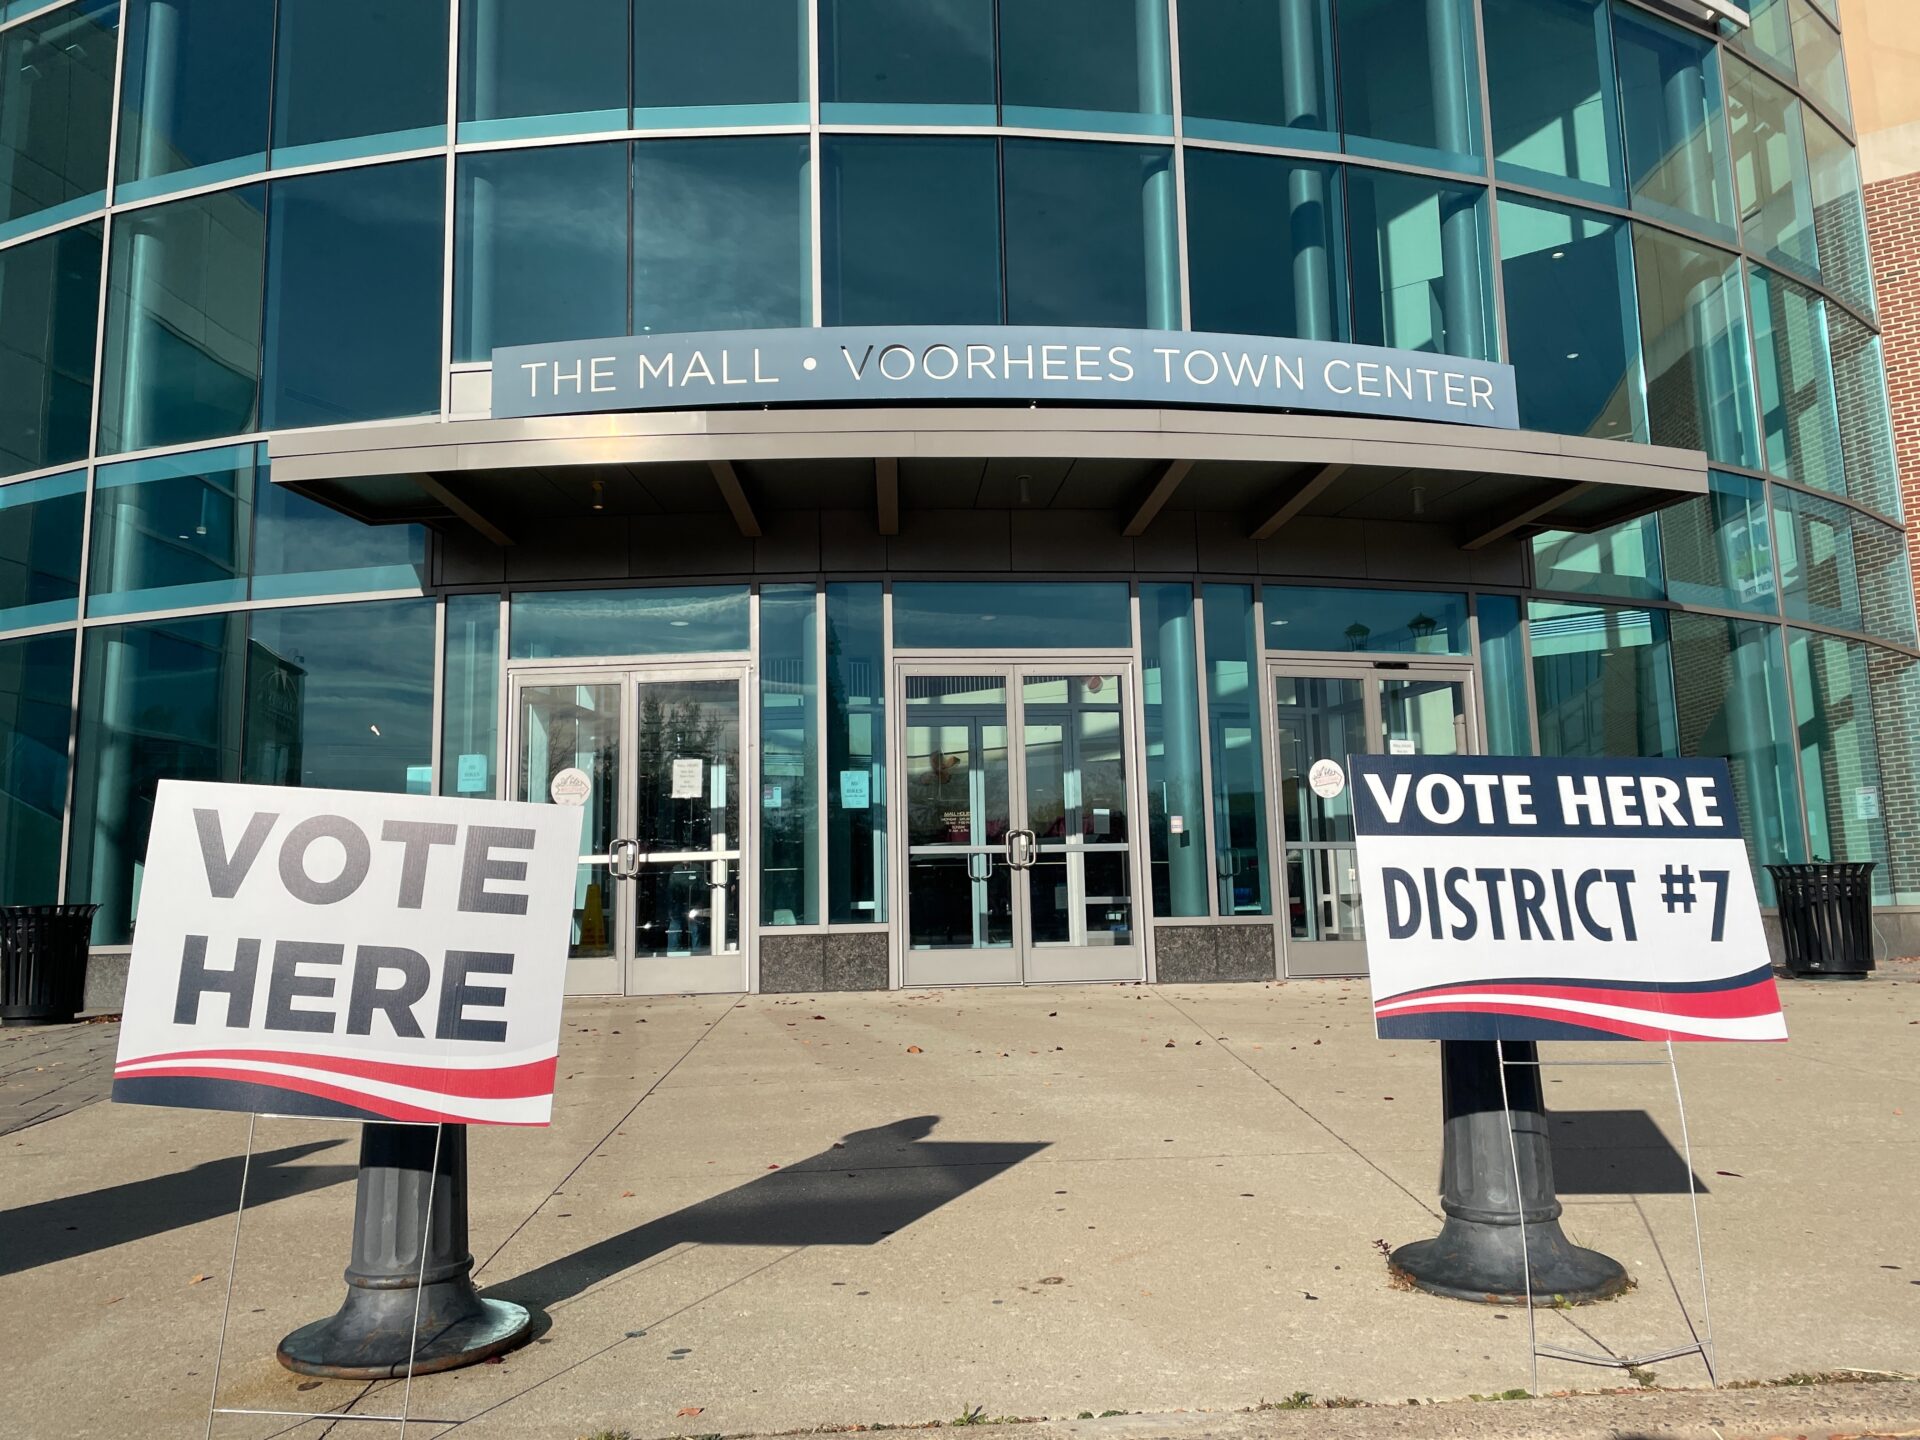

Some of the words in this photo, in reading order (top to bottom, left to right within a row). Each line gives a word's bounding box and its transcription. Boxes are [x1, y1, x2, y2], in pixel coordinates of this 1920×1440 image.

[521, 356, 616, 397] THE
[638, 348, 780, 389] MALL
[840, 343, 1134, 382] VOORHEES
[1154, 348, 1304, 390] TOWN
[1324, 358, 1495, 411] CENTER
[1363, 773, 1537, 825] VOTE
[1557, 775, 1723, 827] HERE
[192, 808, 537, 916] VOTE
[1381, 866, 1637, 942] DISTRICT
[1659, 864, 1730, 942] #7
[173, 935, 516, 1043] HERE
